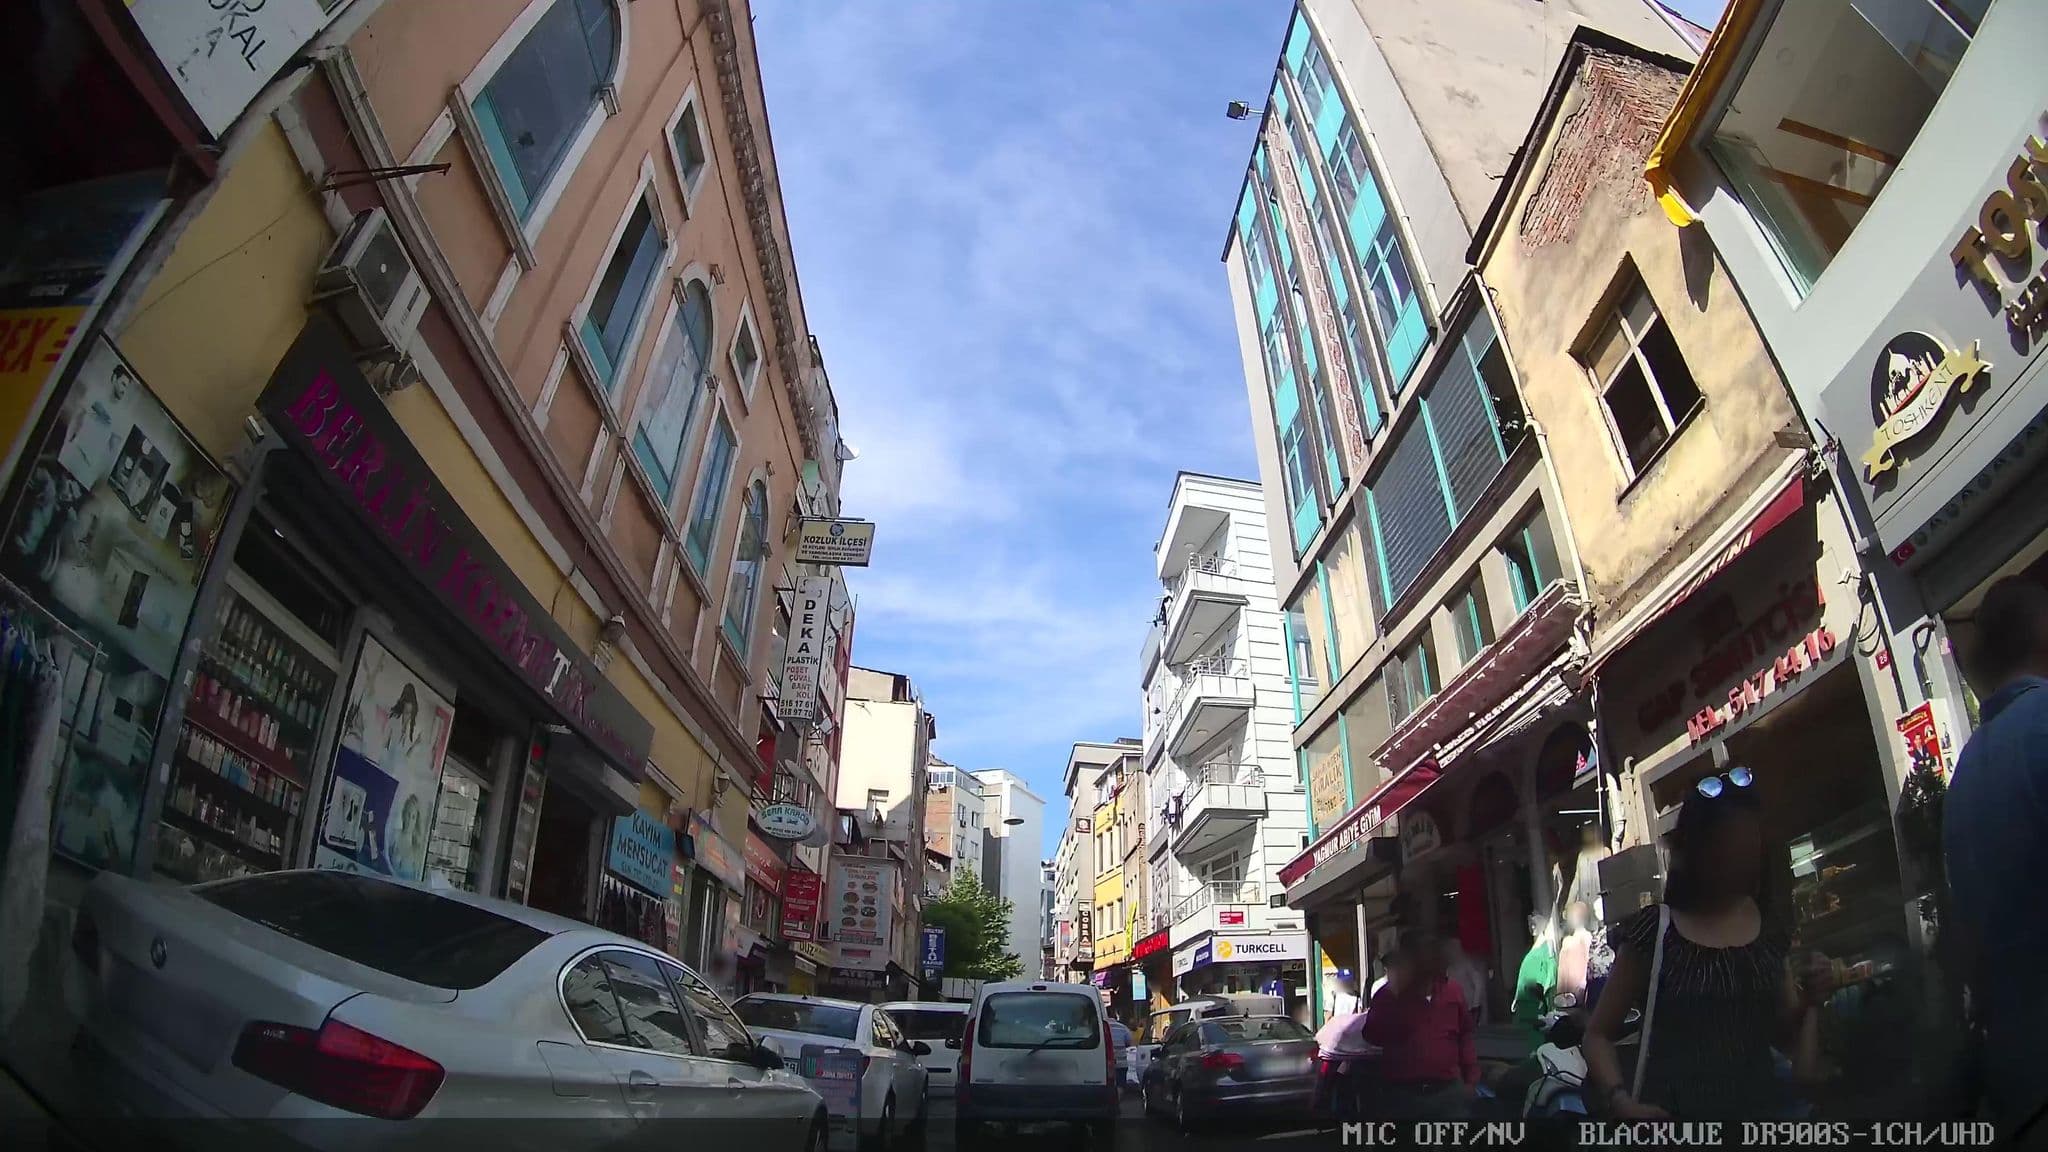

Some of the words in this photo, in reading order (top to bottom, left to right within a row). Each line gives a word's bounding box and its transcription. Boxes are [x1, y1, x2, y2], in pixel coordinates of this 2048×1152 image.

[1880, 364, 1953, 441] TOSHKENT
[804, 536, 837, 545] KOZLUK
[839, 536, 867, 547] İLÇESİ
[798, 599, 815, 653] DEKA
[787, 656, 818, 665] PLASTİK
[1774, 646, 1803, 692] 44
[1805, 626, 1836, 668] 16
[804, 709, 813, 717] 70
[616, 836, 668, 878] MENSUCAT
[1236, 943, 1287, 953] TURKCELL
